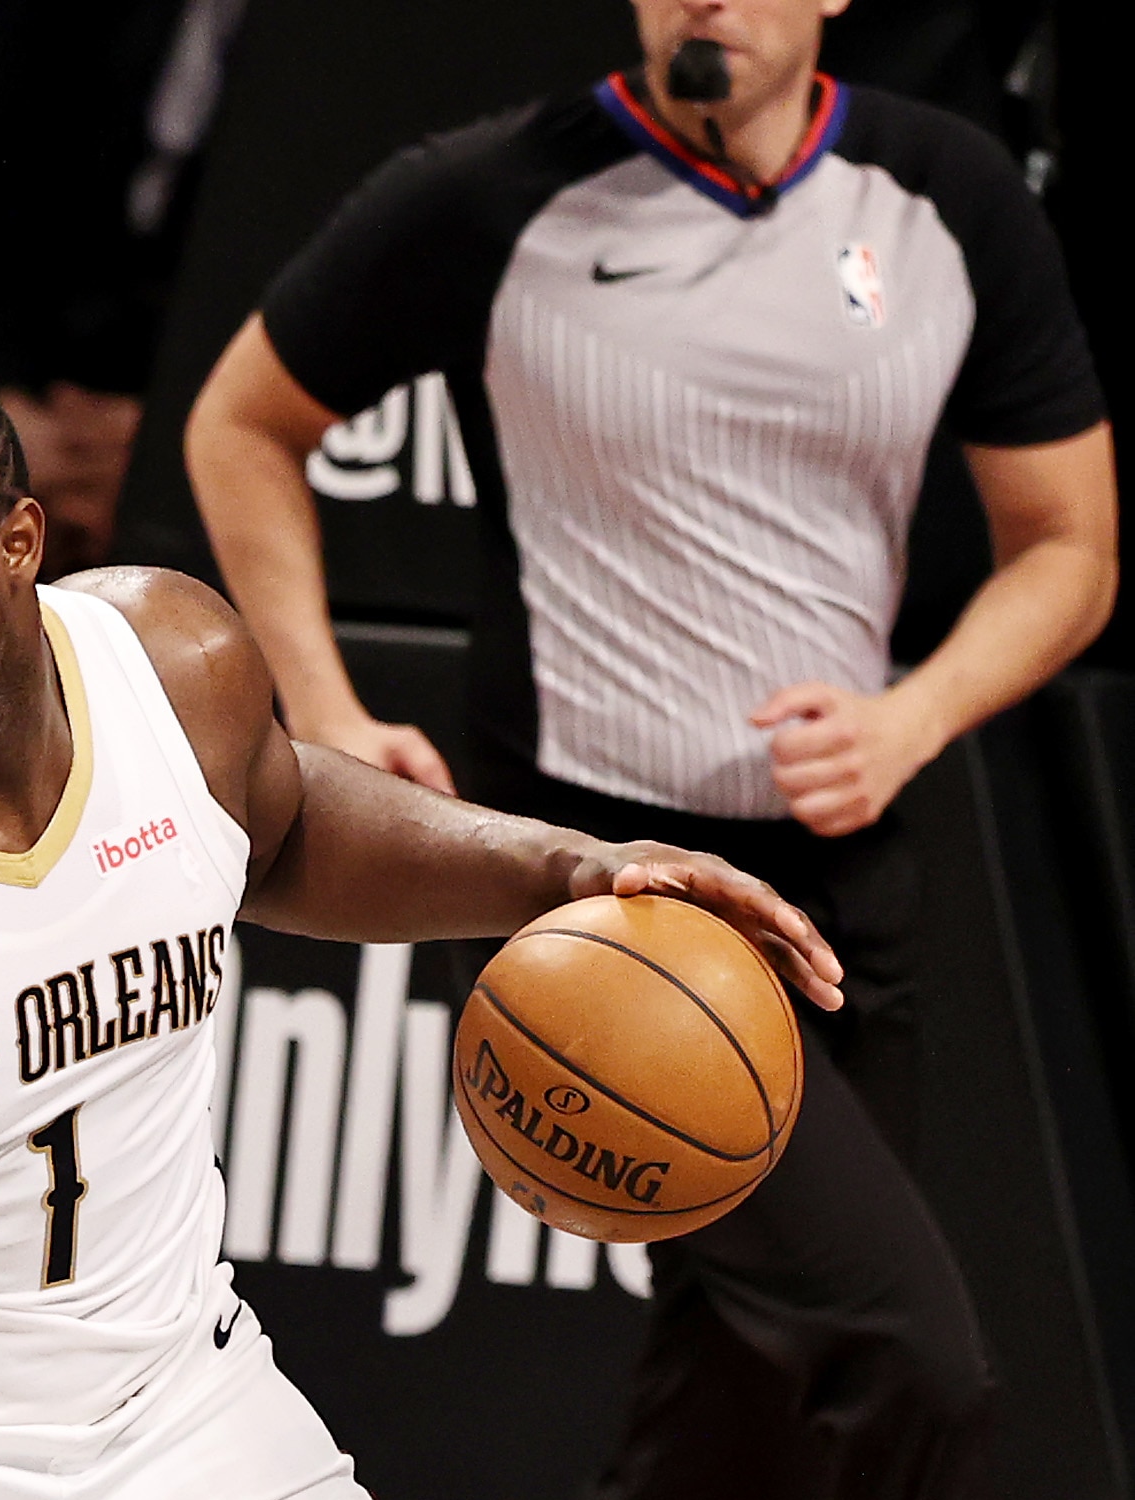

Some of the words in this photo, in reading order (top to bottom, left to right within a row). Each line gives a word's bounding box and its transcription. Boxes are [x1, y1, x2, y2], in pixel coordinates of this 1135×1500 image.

[93, 817, 178, 873] ibotta
[14, 924, 225, 1085] ORLEANS
[25, 1100, 89, 1290] 1
[467, 1038, 671, 1204] SPALDING
